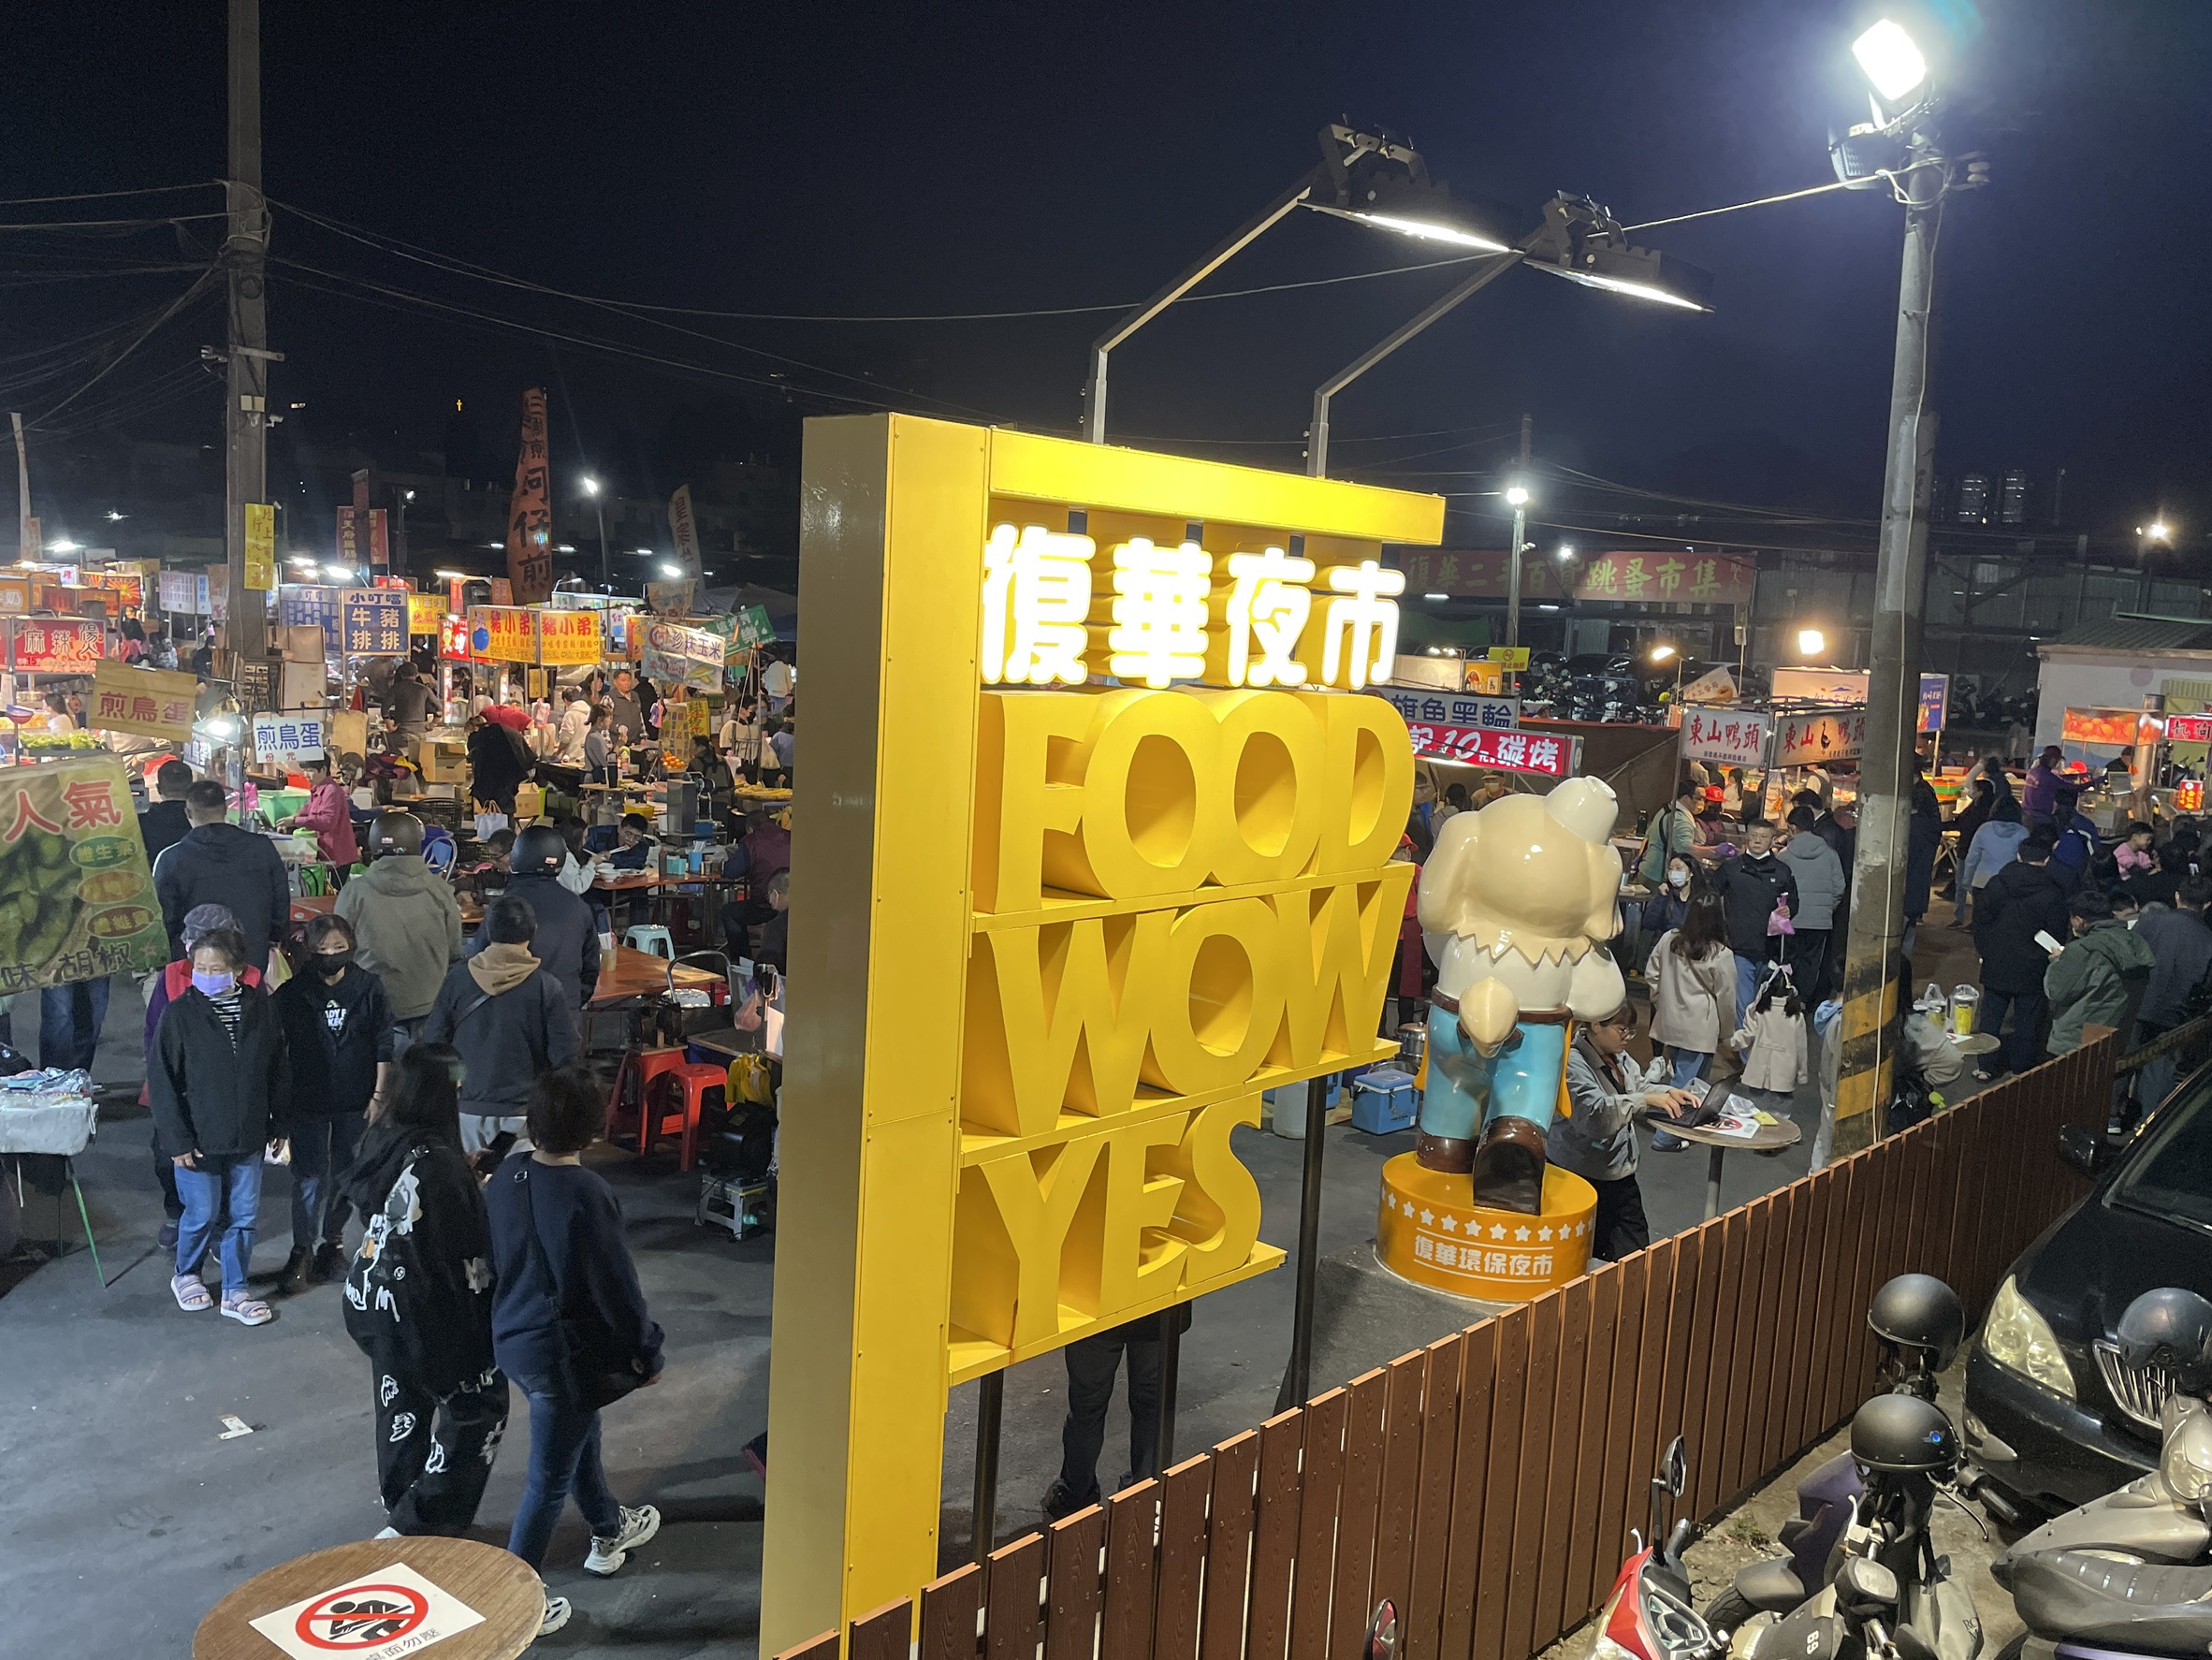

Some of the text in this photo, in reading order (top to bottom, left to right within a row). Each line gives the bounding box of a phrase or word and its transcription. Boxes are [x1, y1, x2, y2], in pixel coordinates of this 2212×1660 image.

[350, 592, 401, 605] 小叮噹
[982, 522, 1406, 689] 復華夜市
[490, 609, 531, 636] 豬小弟
[542, 617, 591, 636] 豬小弟
[672, 632, 721, 661] 珍珠玉米
[96, 691, 190, 724] 煎鳥蛋
[255, 721, 322, 751] 煎鳥蛋
[1688, 714, 1761, 753] 東山鴨頭
[4, 780, 122, 841] 人氣
[994, 689, 1416, 915] FOOD
[985, 877, 1415, 1138] WOW
[978, 1090, 1262, 1351] YES
[1414, 1234, 1553, 1277] 復華環保夜市
